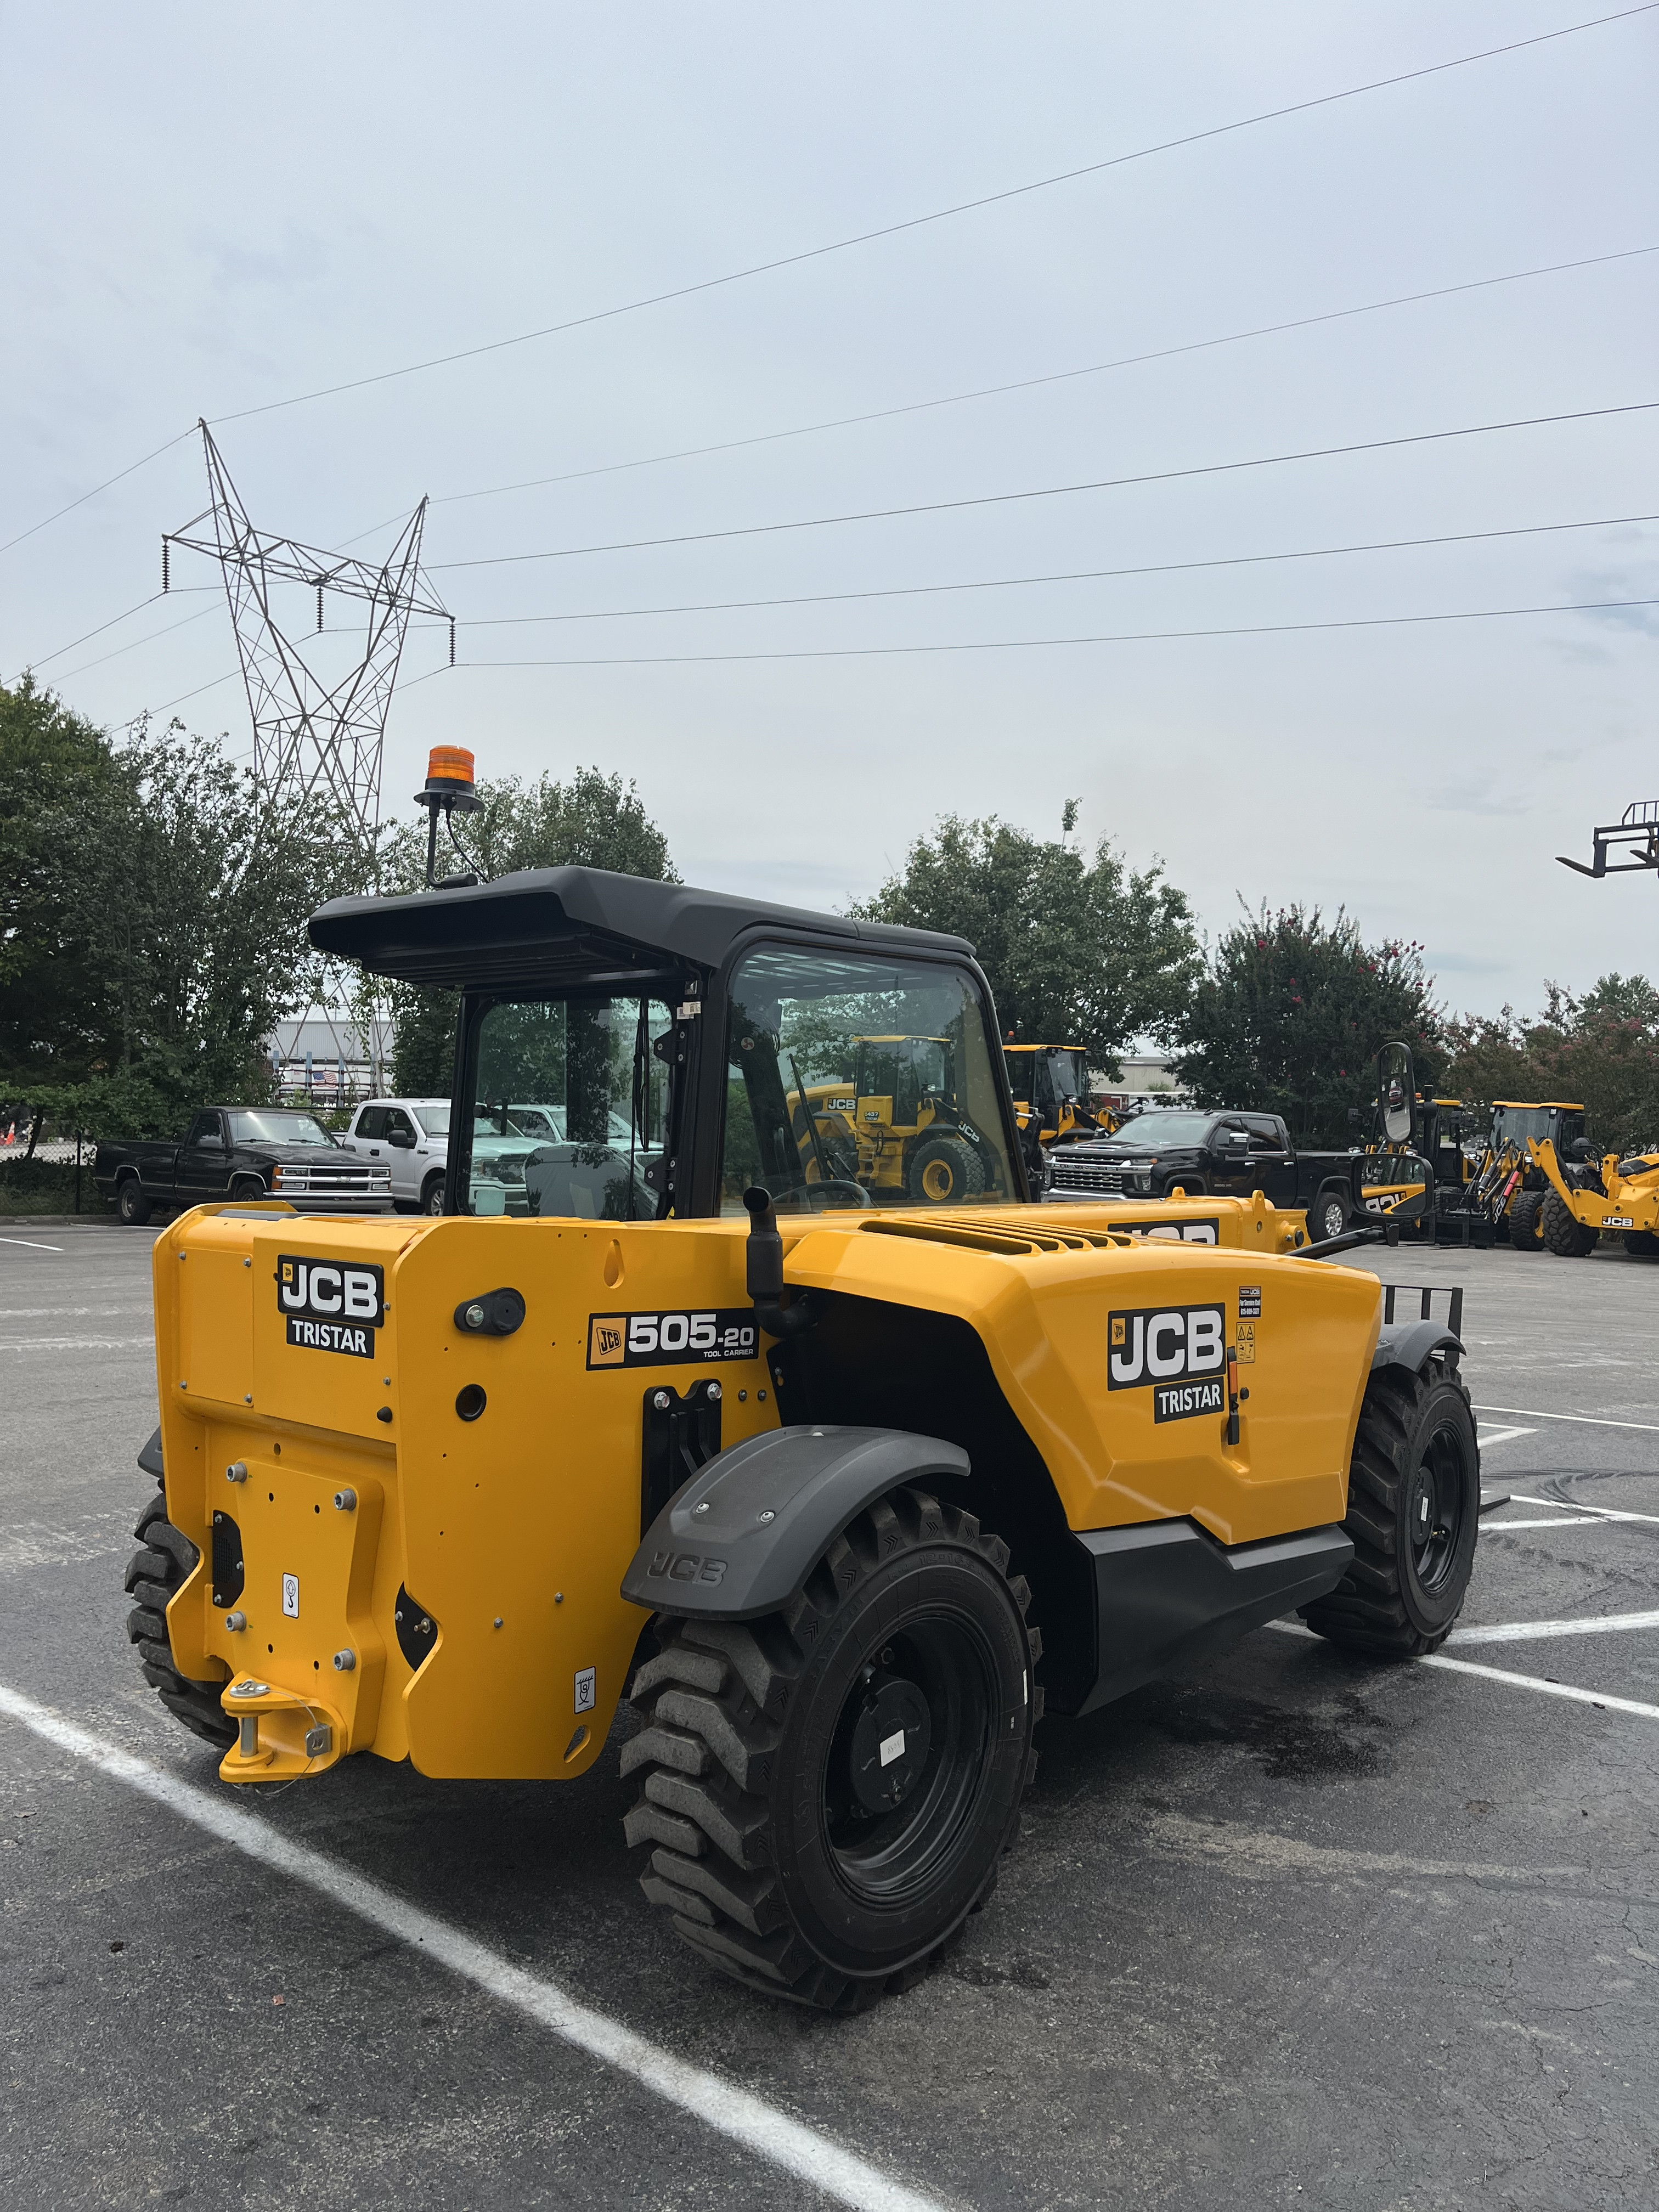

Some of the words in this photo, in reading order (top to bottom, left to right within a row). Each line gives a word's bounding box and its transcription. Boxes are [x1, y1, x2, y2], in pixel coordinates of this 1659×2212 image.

[828, 1099, 856, 1109] JCB
[1052, 1163, 1122, 1171] CHEVROLET
[1494, 1197, 1506, 1224] JCB
[1602, 1217, 1633, 1227] JCB
[283, 1265, 378, 1319] JCB
[292, 1320, 366, 1353] TRISTAR
[601, 1330, 620, 1352] JCB
[1111, 1310, 1223, 1382] JCB
[1159, 1384, 1222, 1415] TRISTAR
[647, 1551, 729, 1588] JCB
